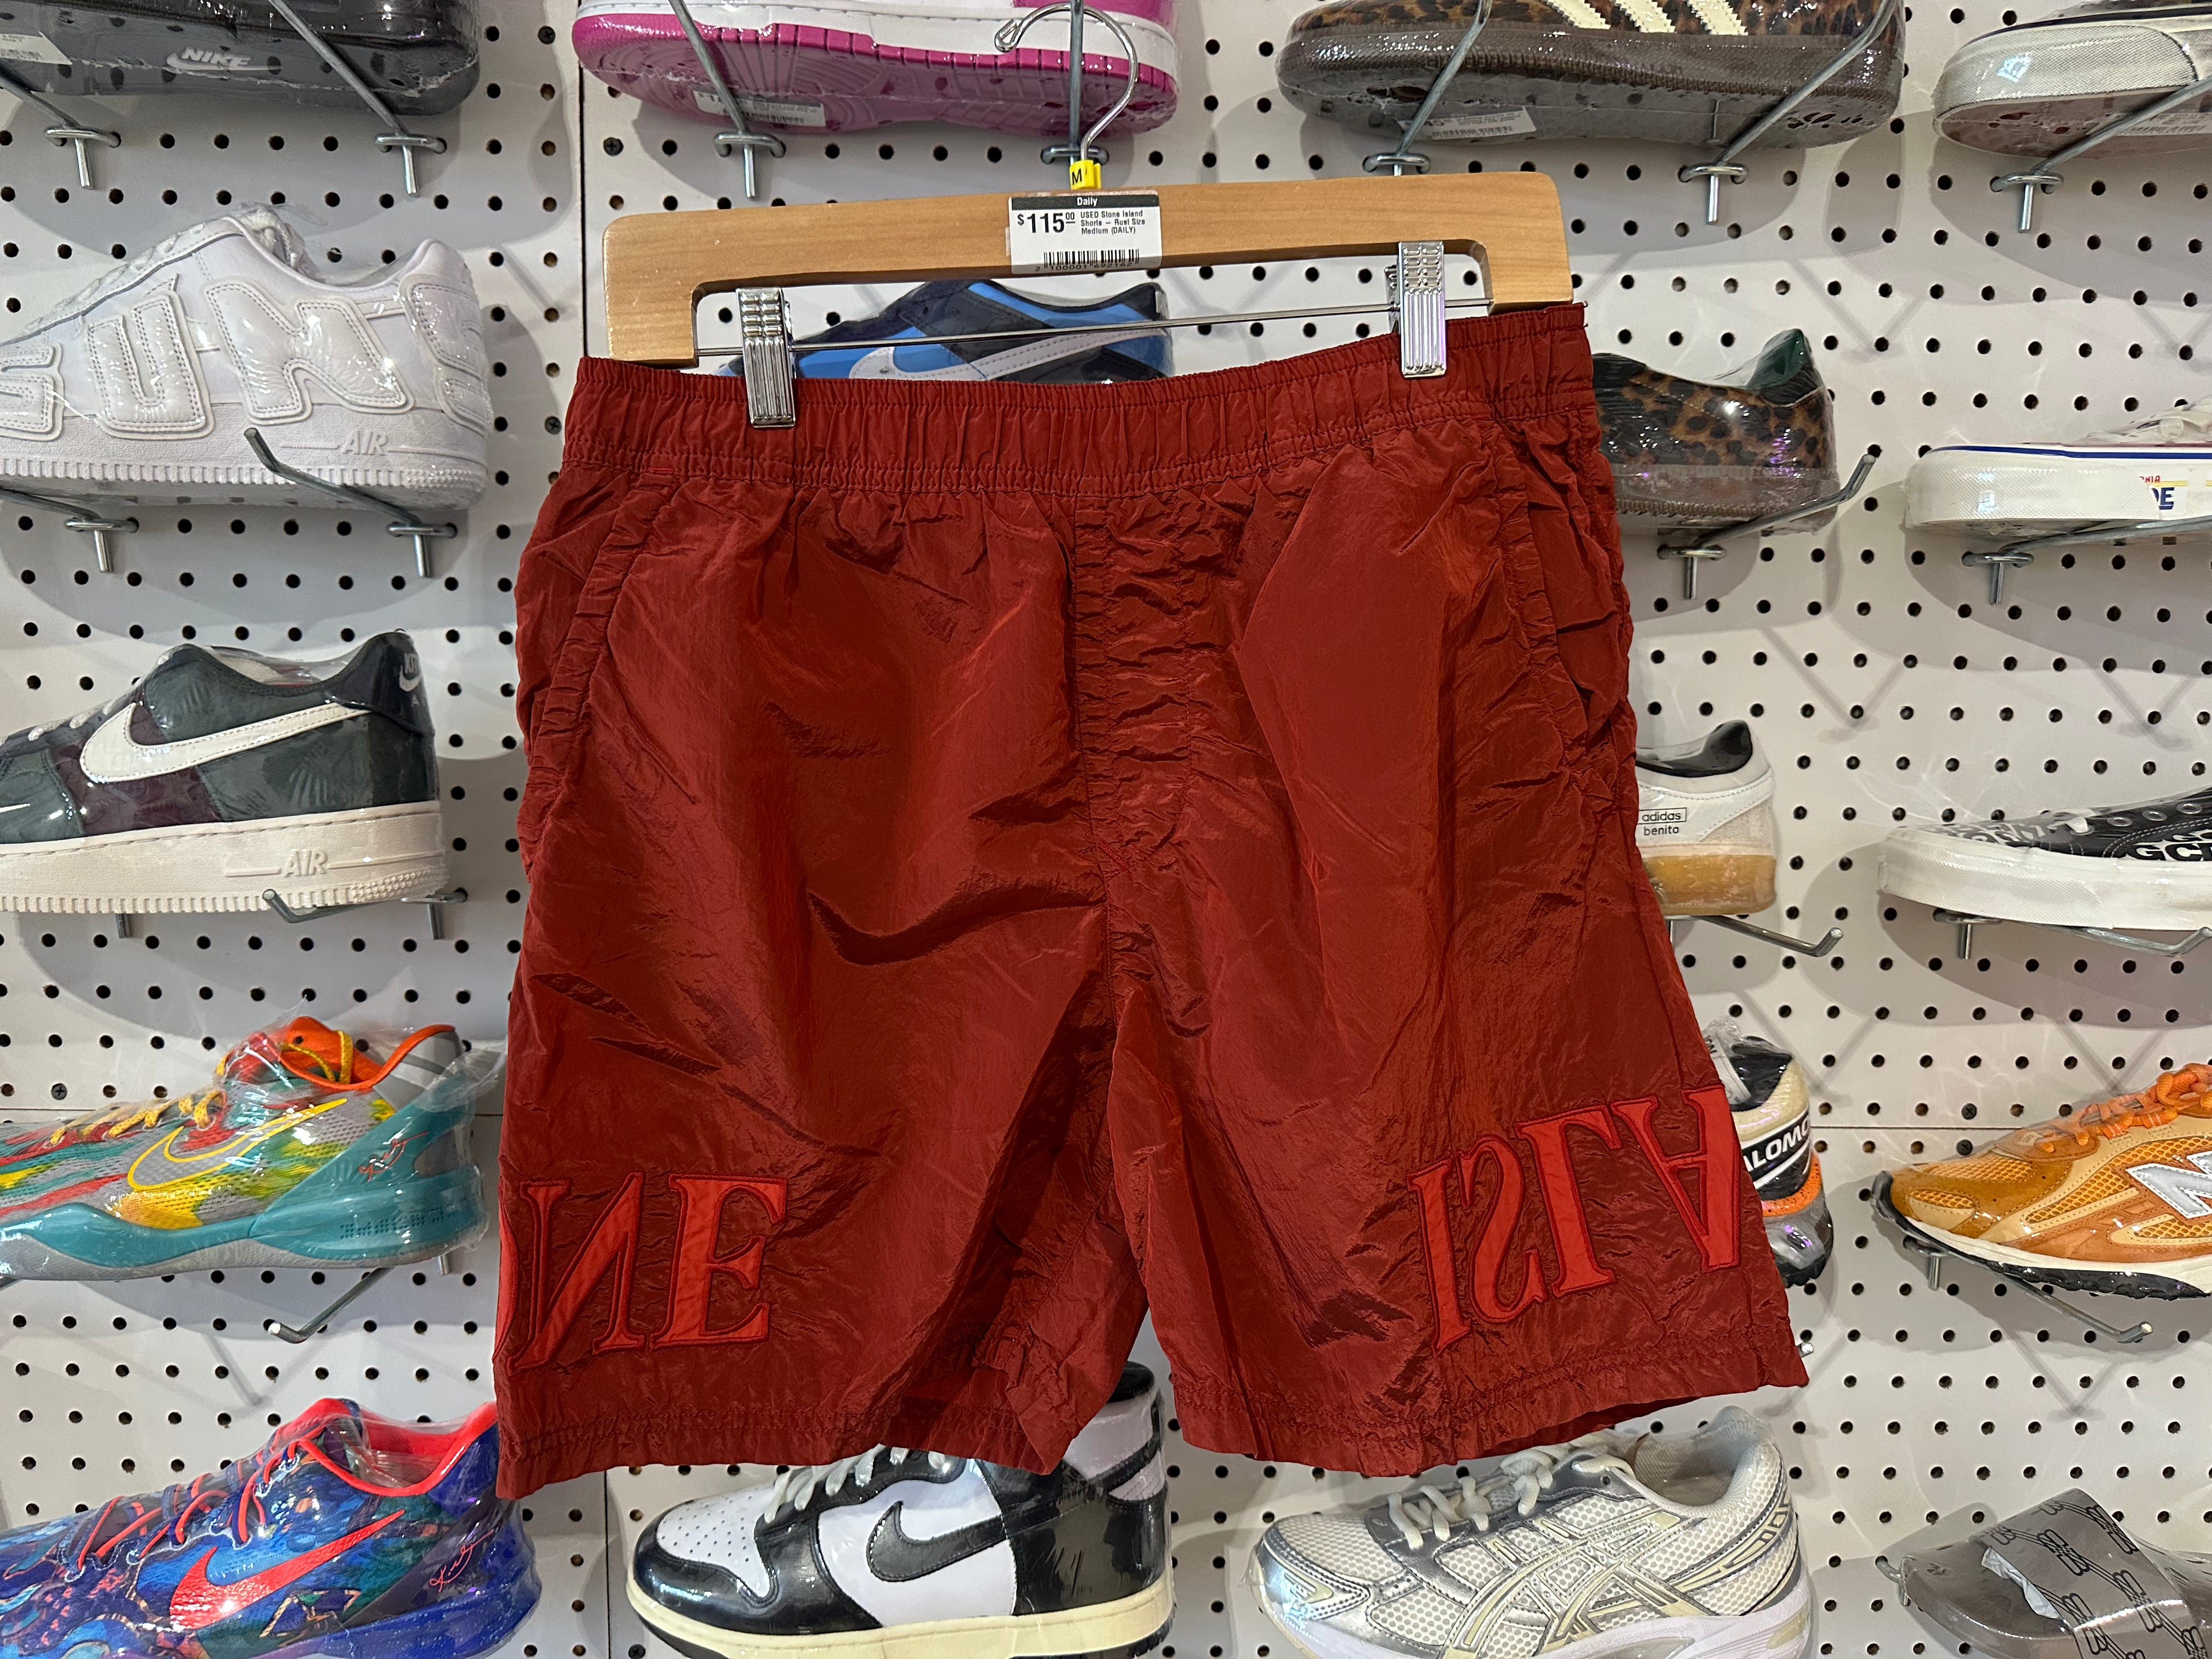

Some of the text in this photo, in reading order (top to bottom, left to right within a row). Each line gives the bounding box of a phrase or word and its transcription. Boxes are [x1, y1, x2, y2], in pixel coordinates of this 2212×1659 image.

[181, 47, 251, 67] NIKE
[1071, 168, 1082, 185] M
[1077, 197, 1098, 207] Daily
[1111, 226, 1136, 235] (DAILY)
[340, 428, 388, 456] AIR
[1641, 811, 1681, 822] adidas
[1643, 825, 1679, 836] benito
[281, 847, 328, 877] AIR
